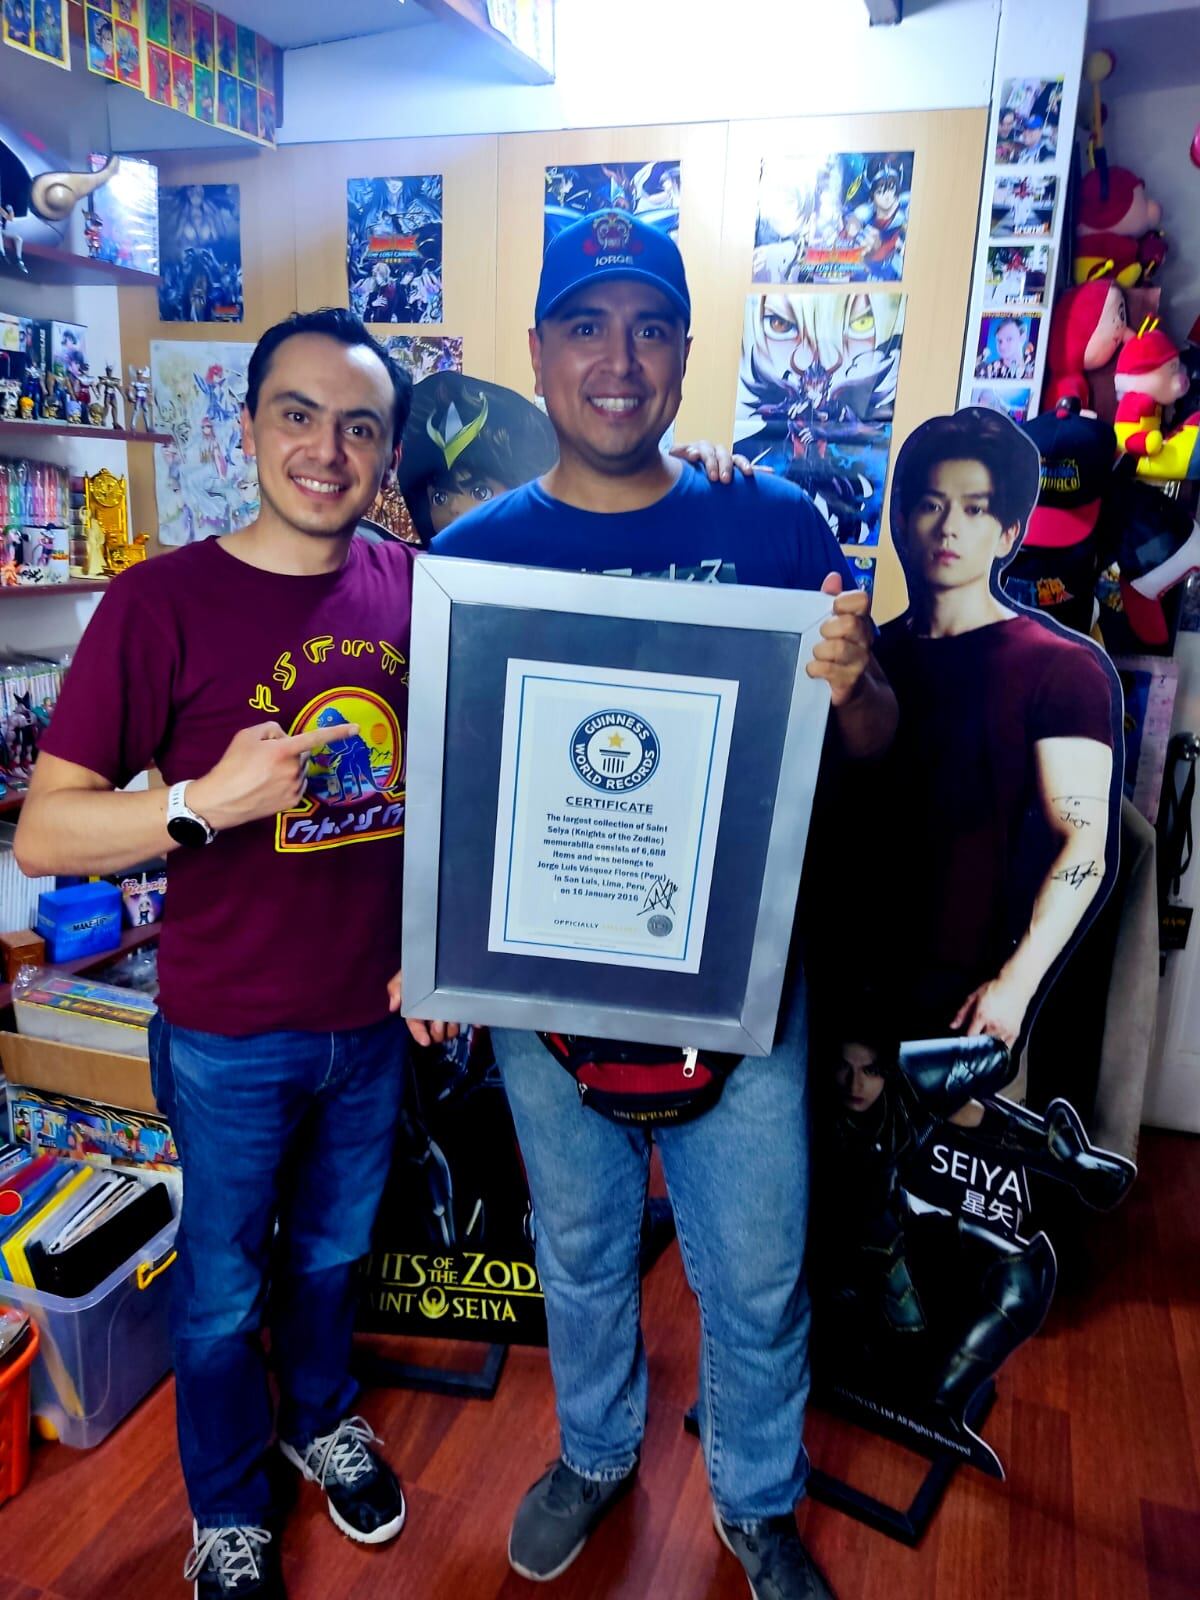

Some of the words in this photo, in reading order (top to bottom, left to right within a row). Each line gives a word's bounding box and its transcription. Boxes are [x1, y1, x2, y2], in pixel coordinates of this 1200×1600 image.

[594, 254, 635, 268] JORGE
[584, 713, 650, 741] GUINNESS
[574, 743, 602, 785] WORLD
[606, 749, 655, 790] RECORDS
[565, 796, 654, 813] CERTIFICATE
[546, 813, 561, 822] The
[563, 815, 592, 825] largest
[593, 818, 634, 829] collection
[635, 822, 645, 830] of
[646, 823, 668, 833] Saint
[547, 826, 569, 835] Seiya
[571, 828, 606, 839] (Knights
[618, 832, 631, 840] the
[633, 834, 665, 846] Zodiac)
[543, 838, 594, 849] memorabilia
[595, 844, 630, 853] consists
[631, 846, 640, 854] of
[552, 850, 575, 859] items
[611, 856, 643, 867] belongs
[645, 860, 654, 868] to
[537, 860, 559, 871] Jorge
[561, 863, 578, 872] Luis
[579, 864, 612, 875] Vásquez
[614, 868, 639, 878] Flores
[563, 875, 579, 883] San
[581, 877, 600, 887] Luis,
[602, 879, 624, 889] Lima,
[626, 881, 647, 892] Peru,
[573, 888, 583, 896] 16
[585, 889, 616, 901] January
[553, 919, 599, 929] OFFICIALLY
[931, 1144, 1022, 1203] SEIYA
[961, 1188, 1014, 1229] 星矢
[433, 1257, 454, 1270] OF
[461, 1252, 543, 1292] ZOD
[427, 1269, 458, 1285] THE
[452, 1297, 518, 1322] SEIYA
[908, 1419, 933, 1438] Rights
[934, 1431, 971, 1457] Reserved
